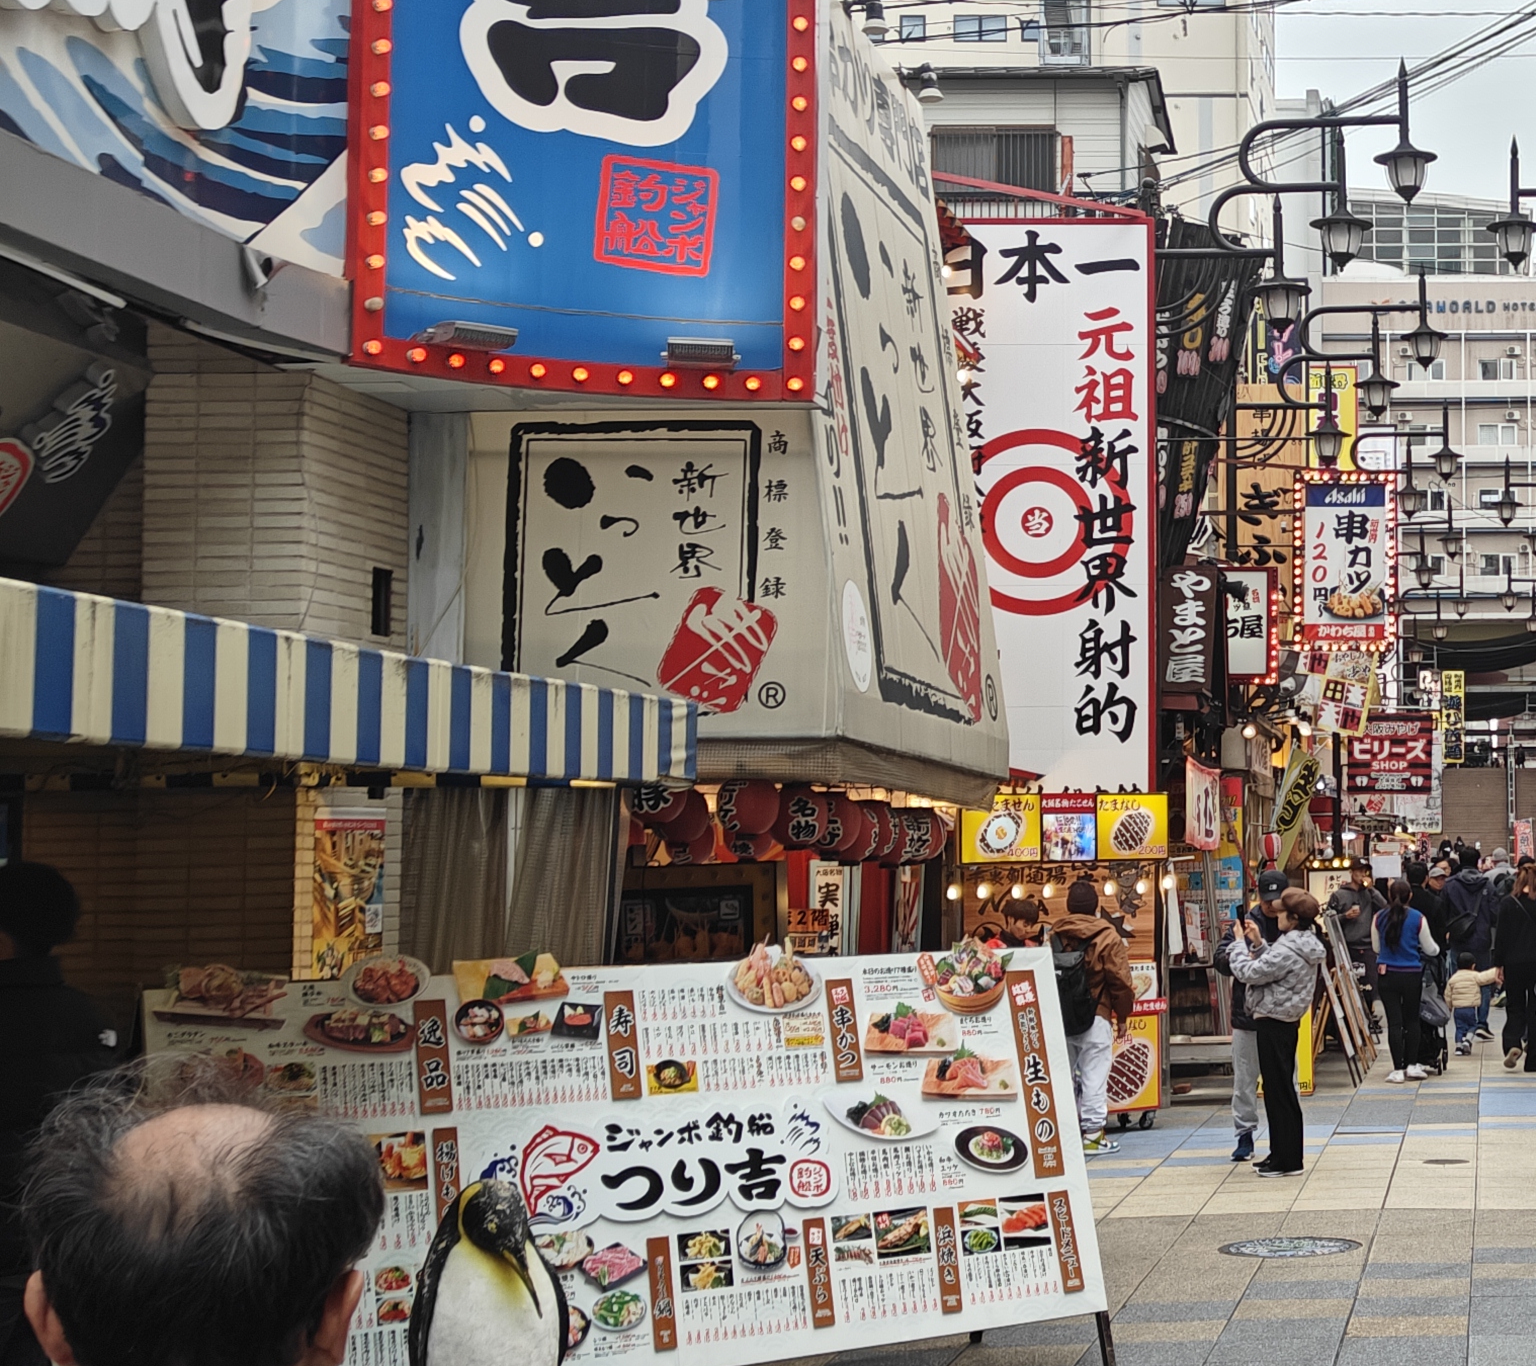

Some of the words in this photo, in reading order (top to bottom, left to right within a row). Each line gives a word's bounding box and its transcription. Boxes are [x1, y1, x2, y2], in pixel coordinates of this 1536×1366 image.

[670, 459, 728, 580] 新世界
[760, 430, 791, 600] 商標登録
[1323, 488, 1367, 505] Asahi
[1332, 509, 1373, 595] 串カツ
[1165, 570, 1212, 685] やまと屋
[1353, 740, 1428, 761] ビリーズ
[1371, 761, 1408, 771] SHOP
[787, 795, 818, 842] 名物
[1006, 847, 1038, 858] 400円
[1138, 846, 1166, 856] 200円
[418, 1015, 449, 1091] 逸品
[609, 1006, 636, 1079] 寿司
[833, 1005, 858, 1069] 串かつ
[1024, 1053, 1056, 1144] 生もの
[604, 1111, 776, 1153] ジャンボ釣船
[435, 1139, 459, 1213] 揚げも
[601, 1147, 787, 1211] つり吉
[936, 1225, 958, 1285] 浜焼き
[1052, 1197, 1079, 1278] スピードメニュー
[809, 1247, 829, 1305] 天ぷら
